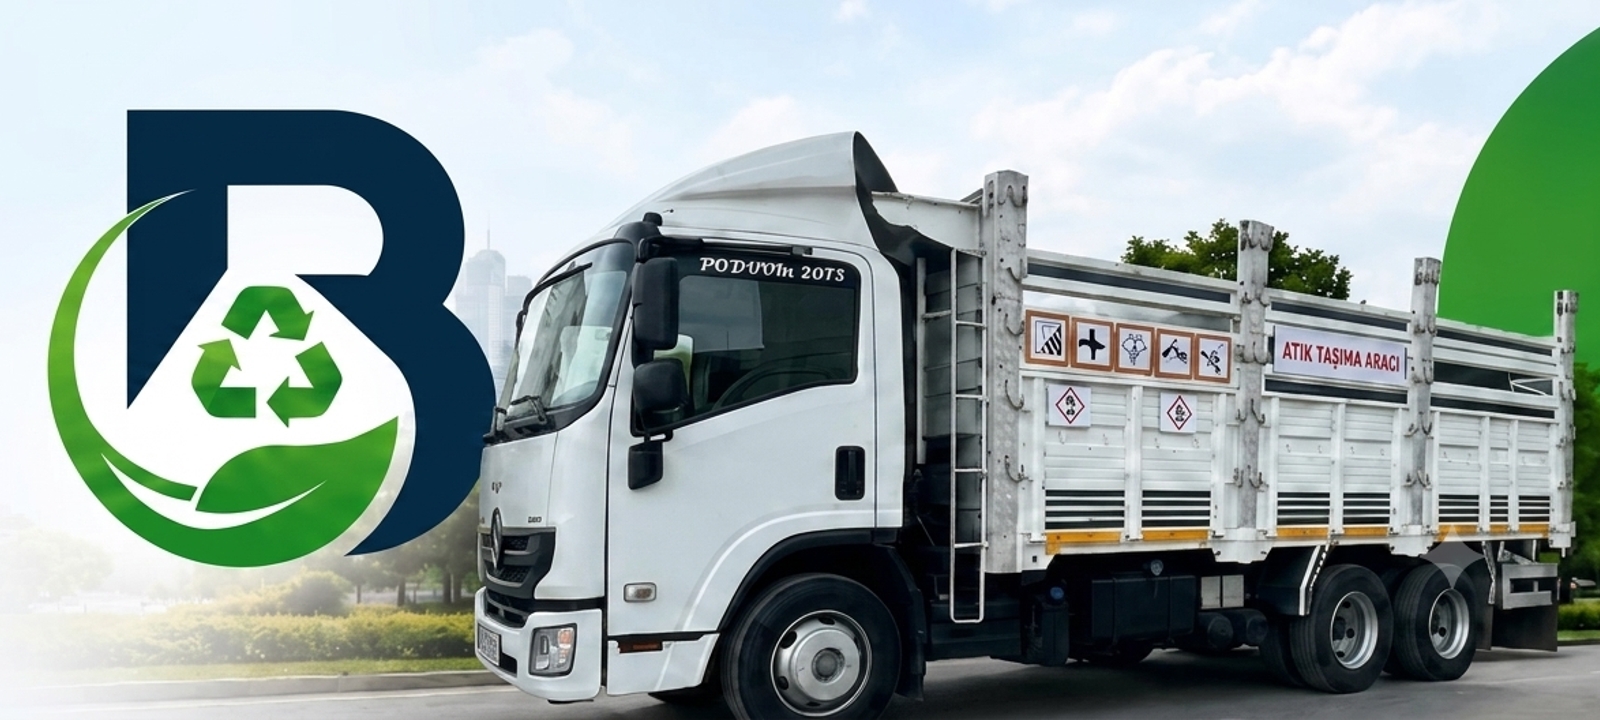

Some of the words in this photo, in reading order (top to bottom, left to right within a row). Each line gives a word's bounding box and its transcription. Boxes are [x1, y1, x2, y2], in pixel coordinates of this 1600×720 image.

[1282, 341, 1313, 363] ATIK
[1316, 345, 1362, 370] TAŞIMA
[1364, 351, 1400, 373] ARACI
